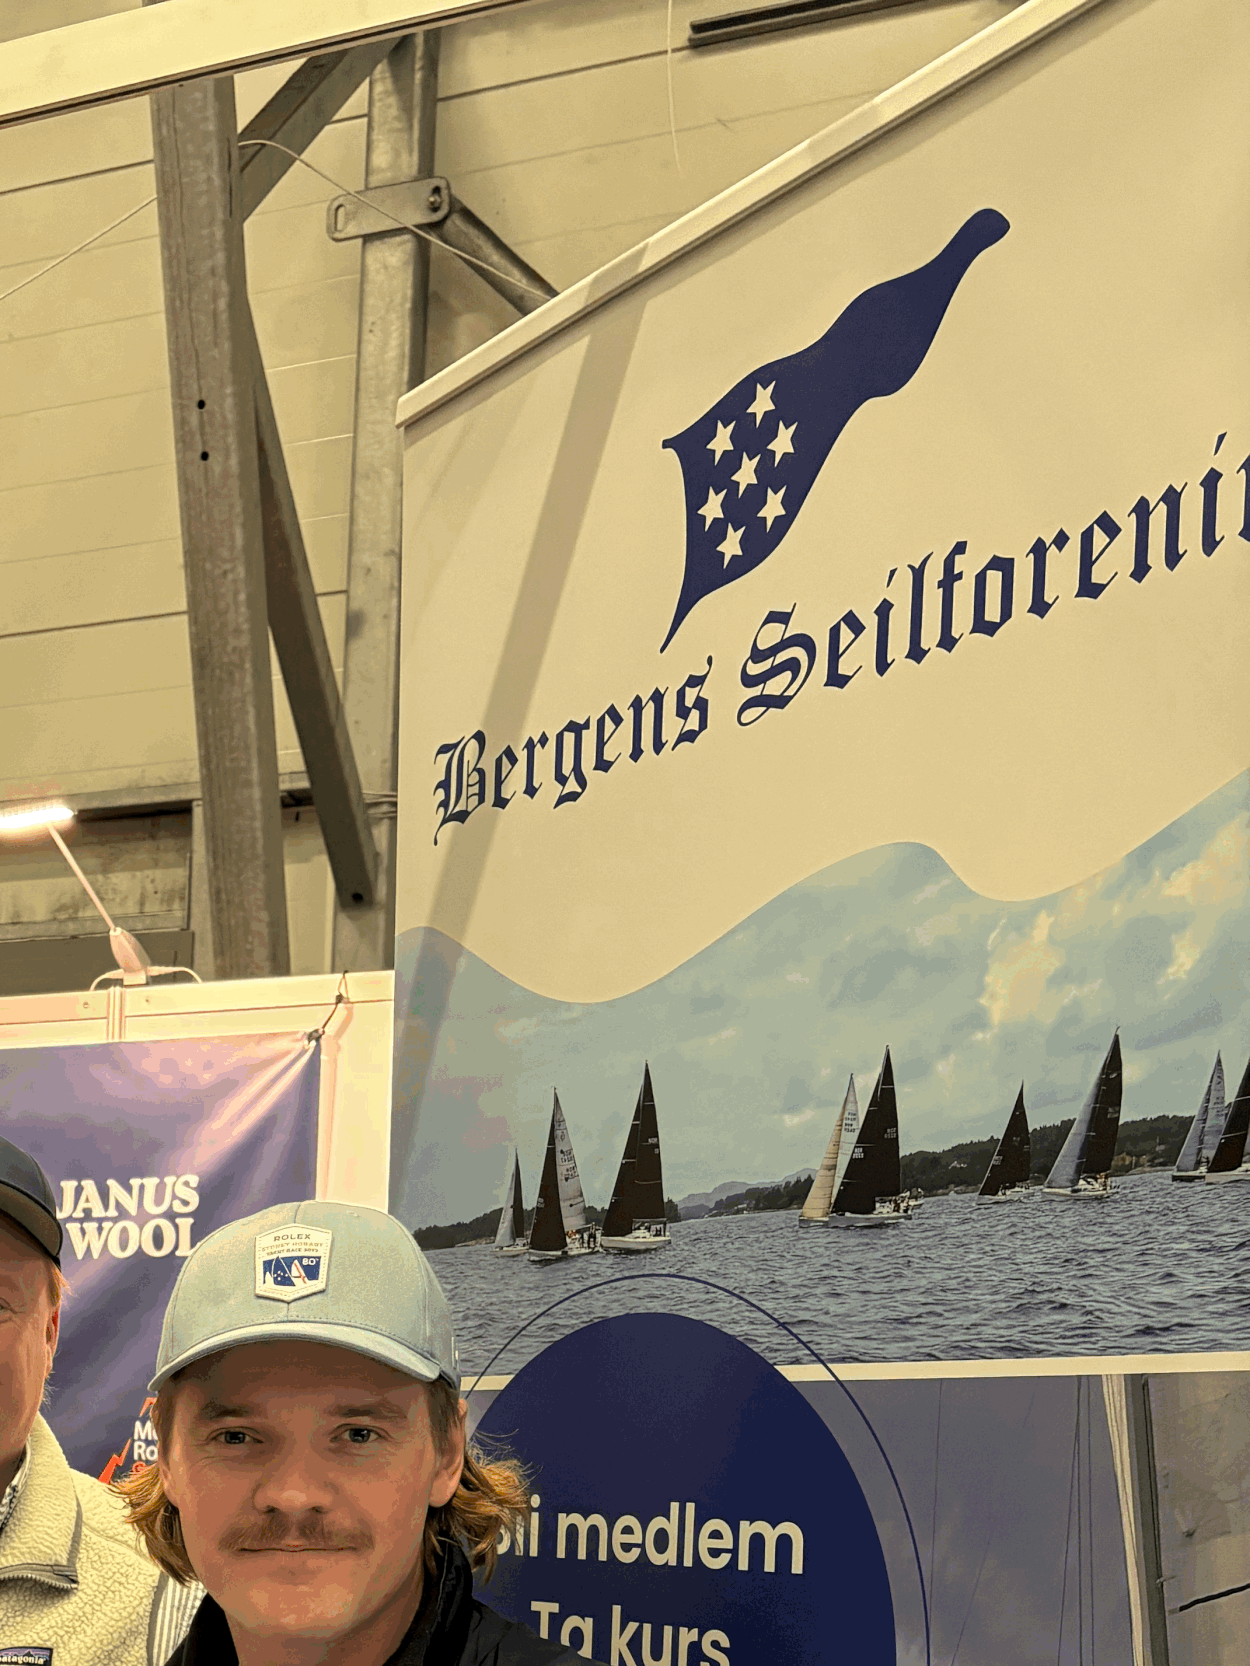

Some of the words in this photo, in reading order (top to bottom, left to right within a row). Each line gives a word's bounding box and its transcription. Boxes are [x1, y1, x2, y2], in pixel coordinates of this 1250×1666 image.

[433, 654, 713, 847] Bergens
[56, 1174, 200, 1220] JANUS
[66, 1216, 200, 1261] WOOL
[273, 1233, 311, 1242] ROLEX
[133, 1441, 158, 1461] Ro
[497, 1493, 541, 1557] li
[556, 1502, 804, 1575] medlem
[530, 1600, 593, 1661] Ta
